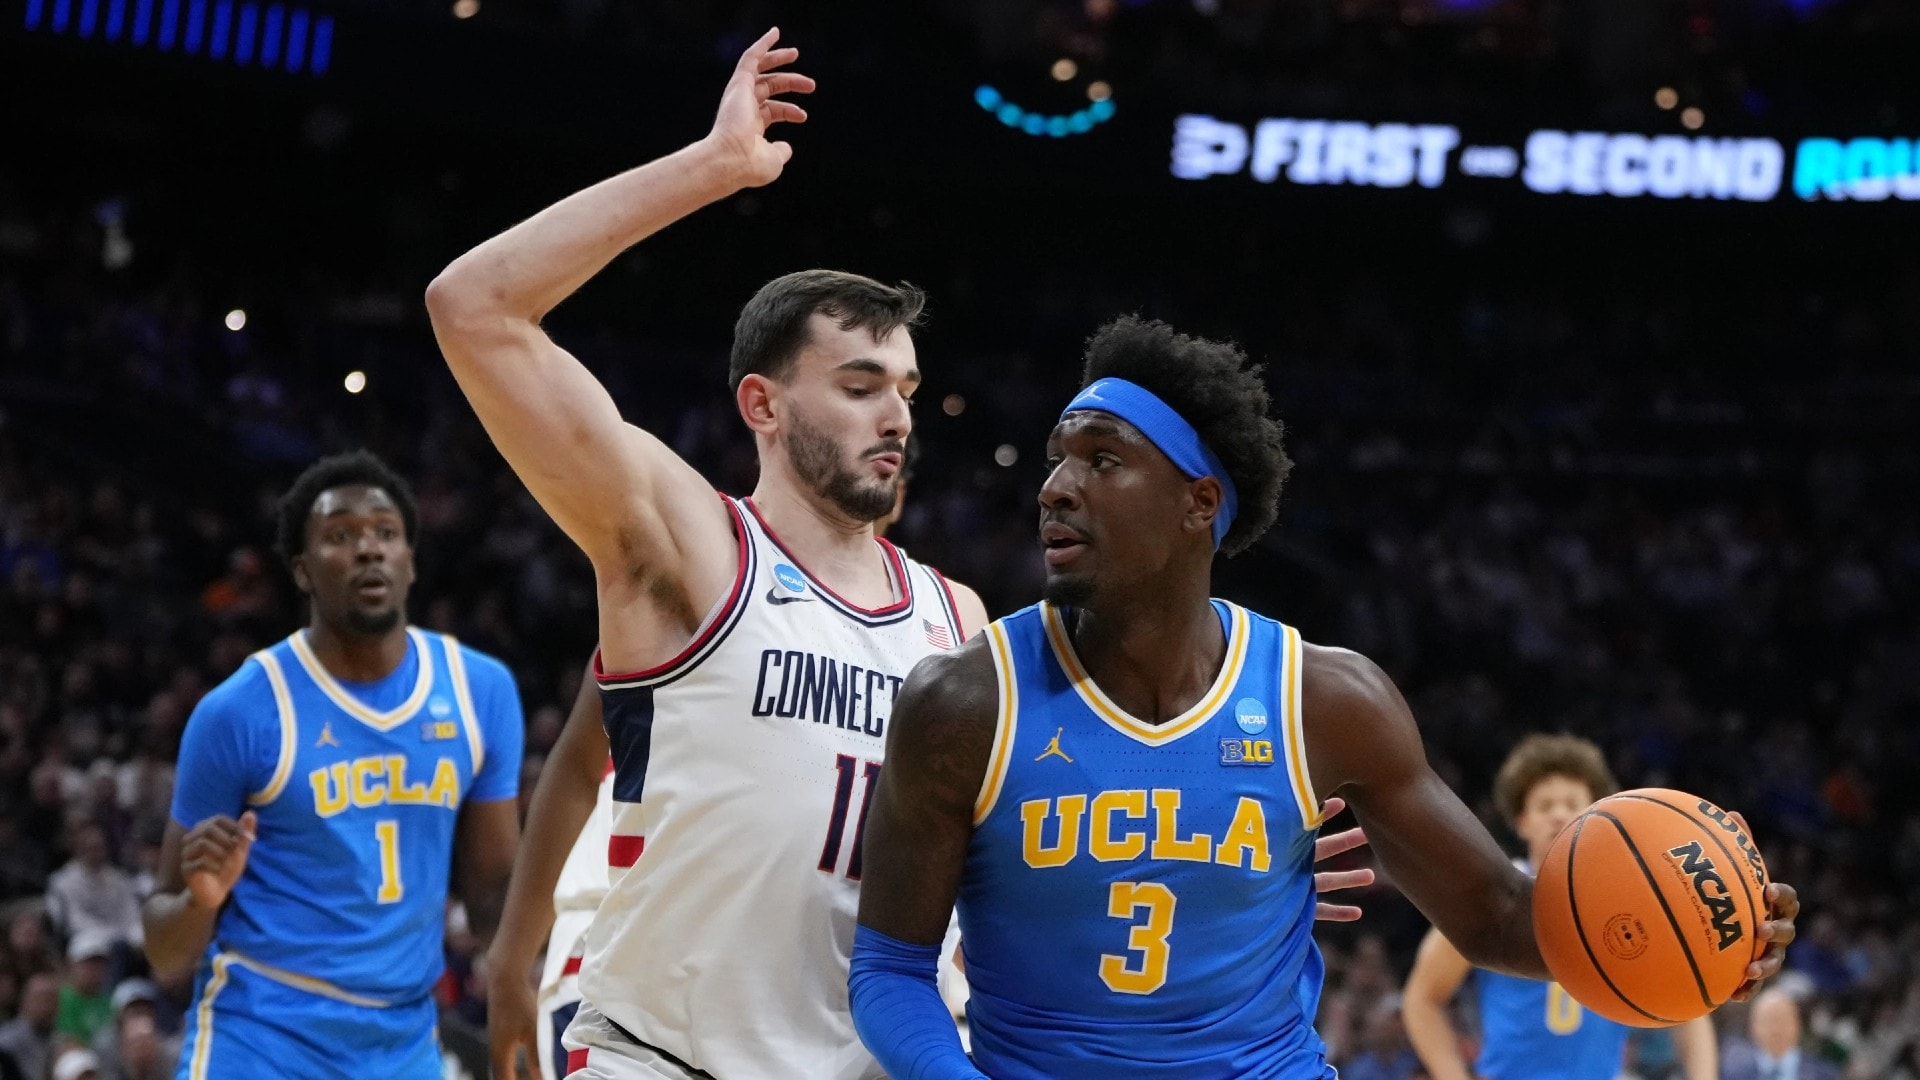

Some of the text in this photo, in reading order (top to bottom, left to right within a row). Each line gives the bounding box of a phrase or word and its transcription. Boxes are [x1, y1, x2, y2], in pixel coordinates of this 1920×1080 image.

[1251, 118, 1461, 188] FIRST
[1522, 129, 1785, 200] SECOND
[779, 572, 804, 588] NCAA
[1239, 714, 1268, 725] NCAA
[309, 754, 460, 818] UCLA
[375, 820, 403, 904] 1
[1021, 789, 1272, 872] UCLA
[1667, 840, 1743, 952] NCAA
[1690, 896, 1708, 925] GAME
[1098, 881, 1177, 995] 3
